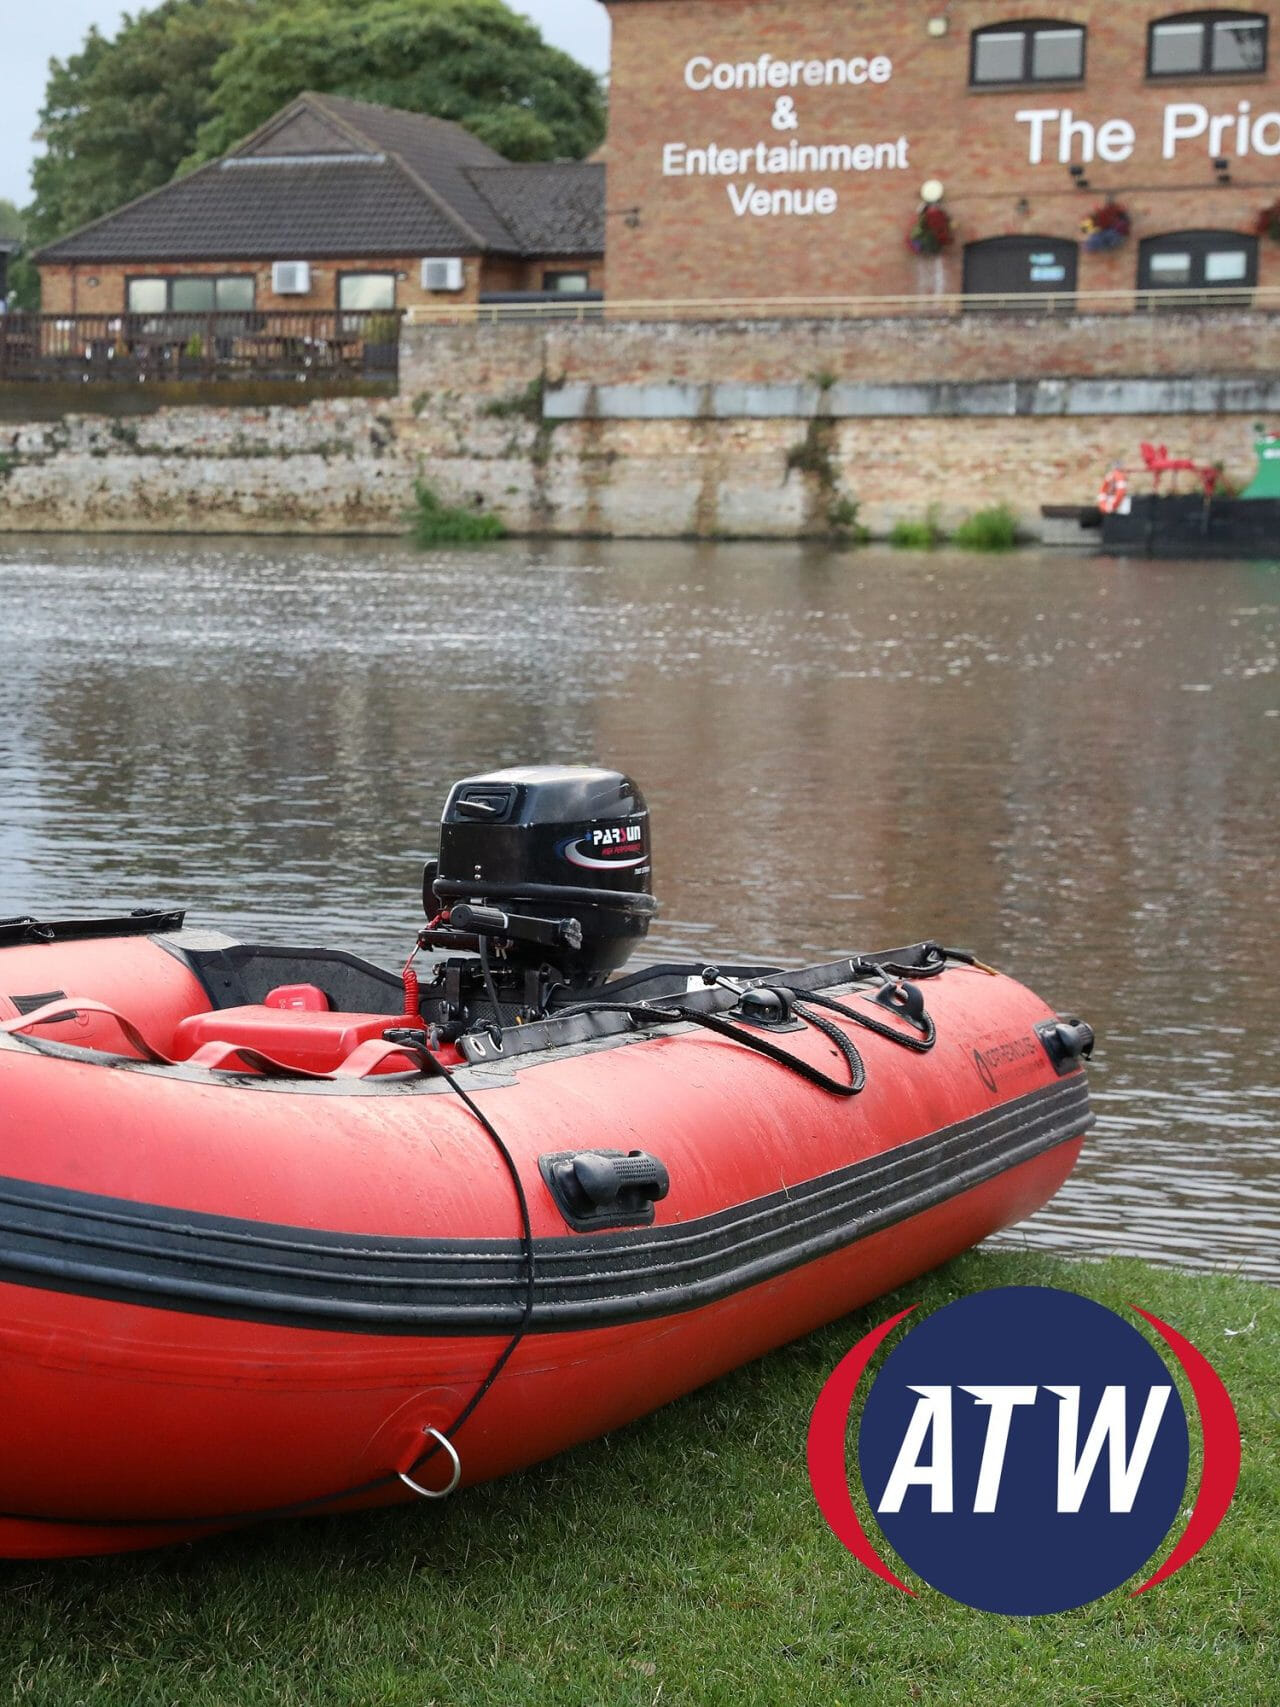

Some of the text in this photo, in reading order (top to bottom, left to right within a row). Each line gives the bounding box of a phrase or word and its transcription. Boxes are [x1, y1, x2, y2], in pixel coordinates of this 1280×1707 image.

[684, 53, 892, 91] Conference
[771, 95, 798, 131] &
[1015, 108, 1136, 165] The
[662, 136, 909, 176] Entertainment
[726, 182, 837, 217] Venue
[593, 825, 641, 846] PARSUN
